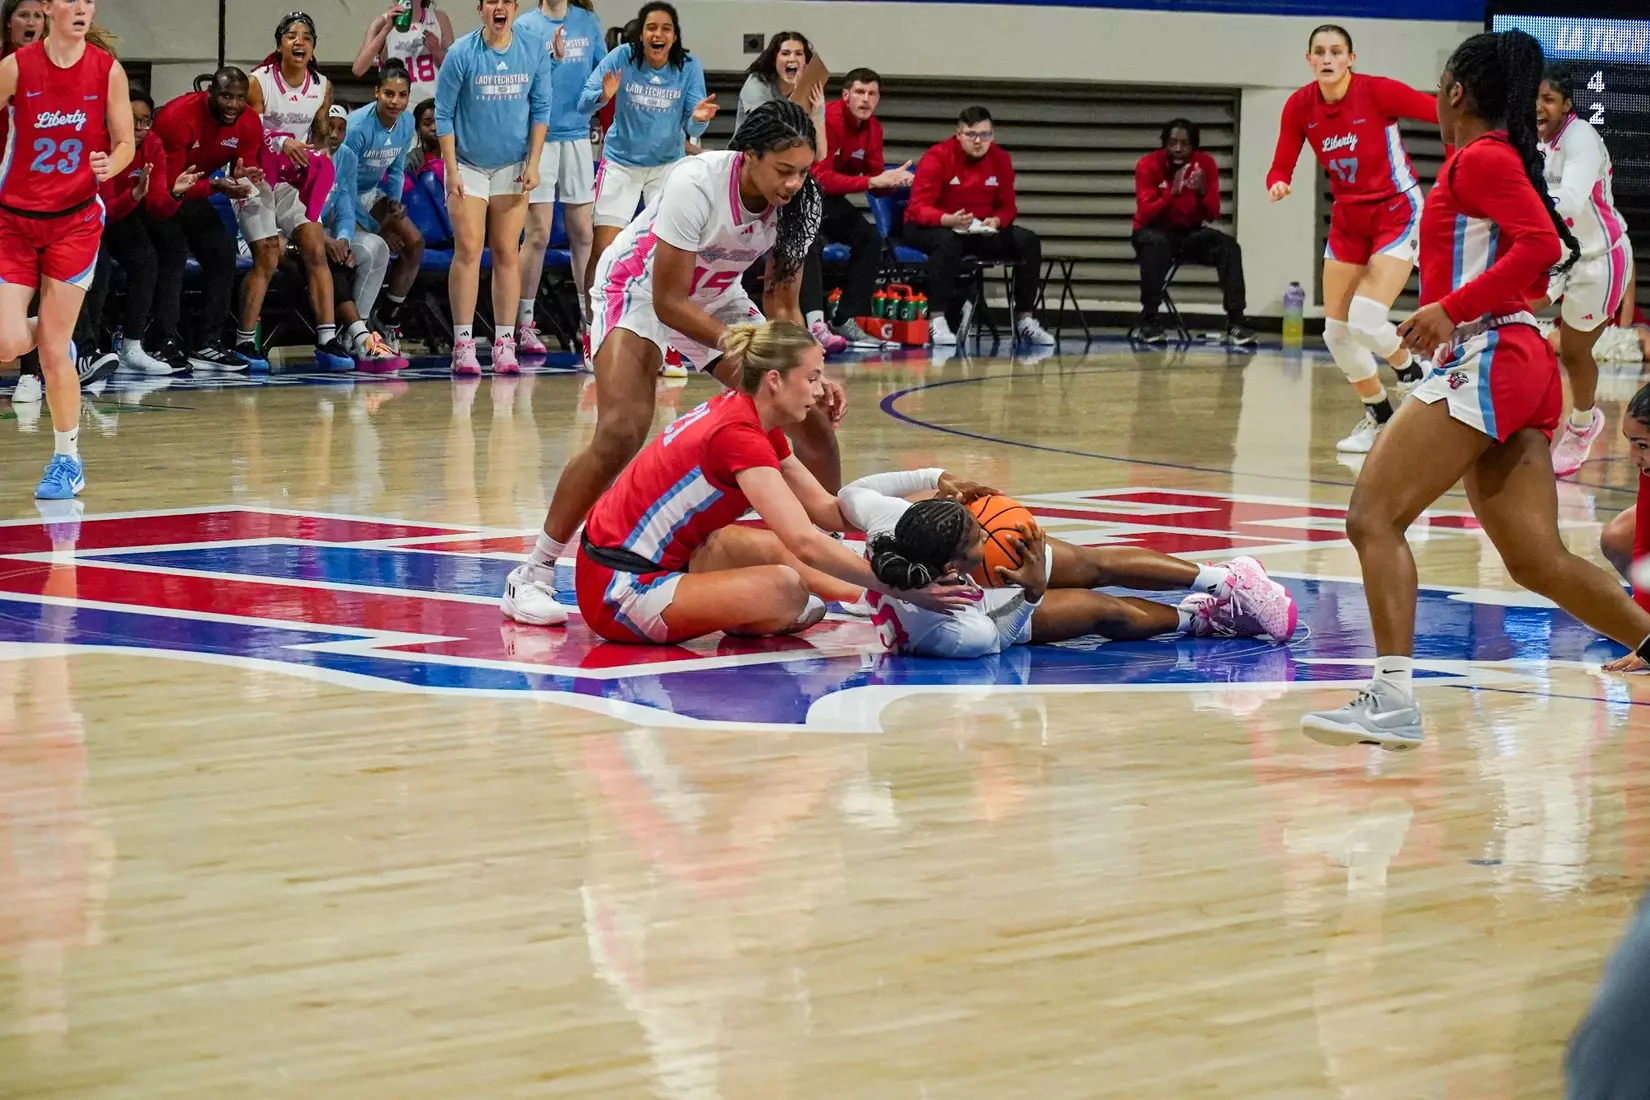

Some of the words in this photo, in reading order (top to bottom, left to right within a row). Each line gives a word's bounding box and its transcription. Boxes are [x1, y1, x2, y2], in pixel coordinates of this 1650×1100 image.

[1556, 25, 1584, 51] LA
[1589, 26, 1649, 53] TECH
[405, 54, 436, 82] 18
[475, 75, 492, 85] LADY
[493, 73, 529, 84] TECHSTERS
[626, 83, 643, 95] LADY
[644, 86, 681, 99] TECHSTERS
[1587, 71, 1605, 92] 4
[34, 109, 87, 131] Liberty
[1589, 102, 1605, 124] 2
[1322, 132, 1358, 152] Liberty
[30, 137, 83, 174] 23
[1329, 156, 1358, 184] 17
[688, 265, 740, 297] 15
[881, 323, 893, 339] G
